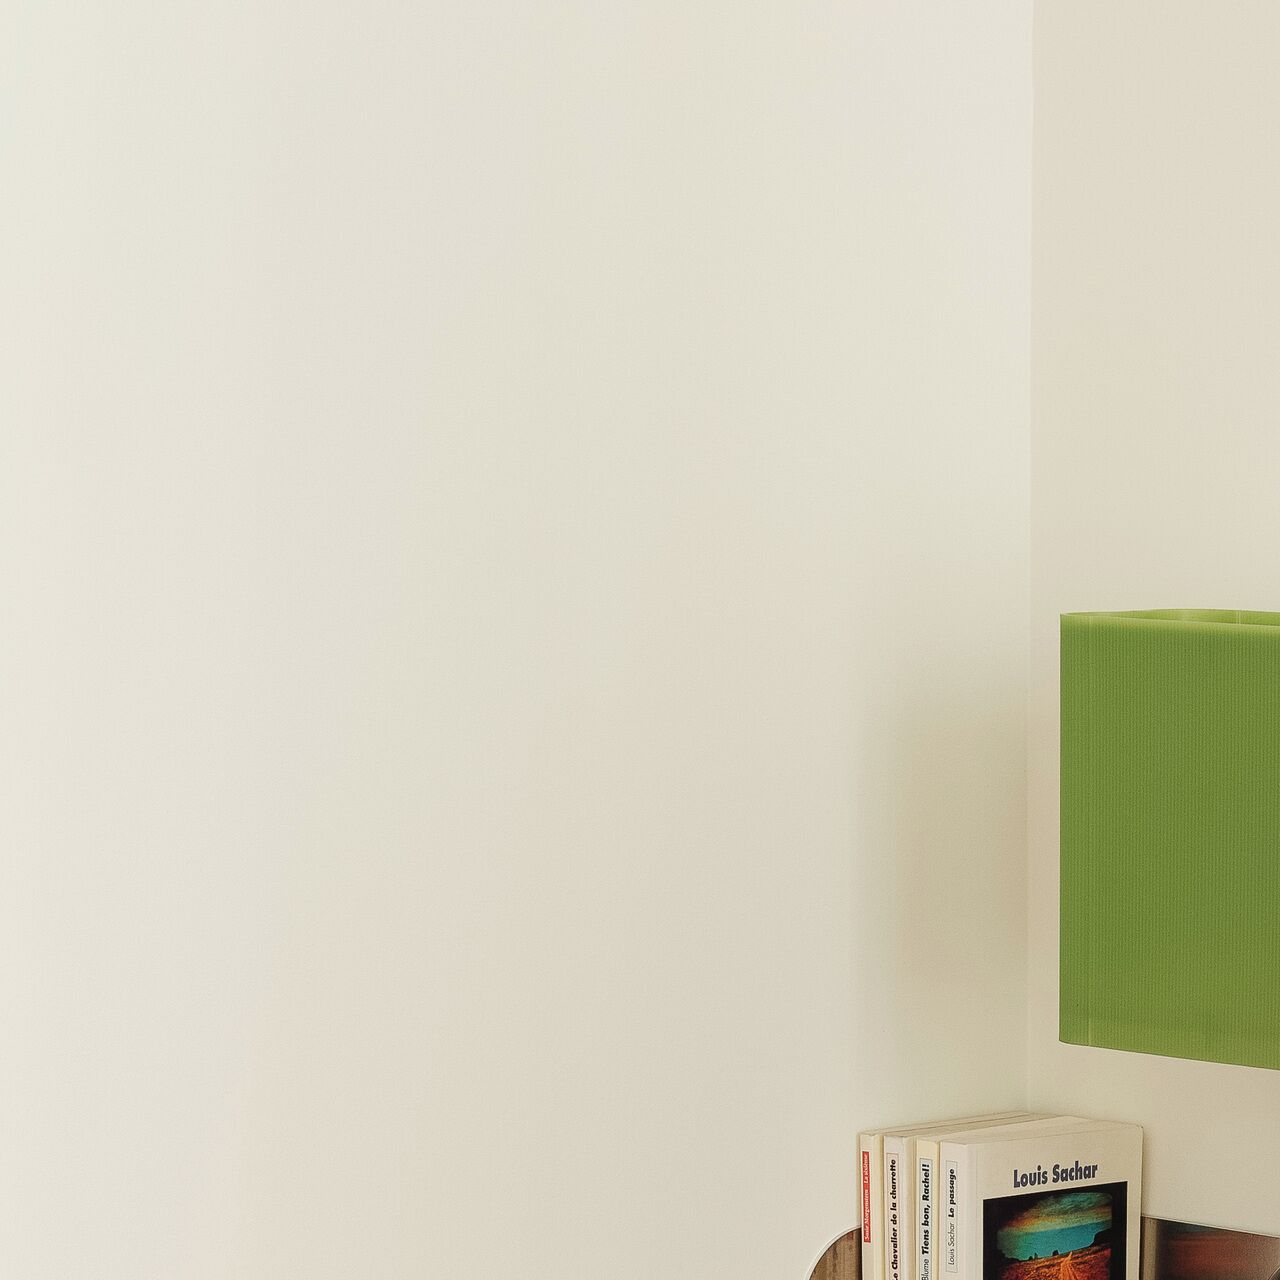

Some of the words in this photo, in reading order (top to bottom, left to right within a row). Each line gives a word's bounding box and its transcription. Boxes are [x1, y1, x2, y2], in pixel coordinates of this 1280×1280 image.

[1014, 1165, 1048, 1188] Louis
[1052, 1160, 1098, 1184] Sachar
[948, 1168, 957, 1206] passage
[921, 1204, 931, 1227] bon,
[948, 1207, 955, 1218] Le
[921, 1229, 930, 1254] Tiens
